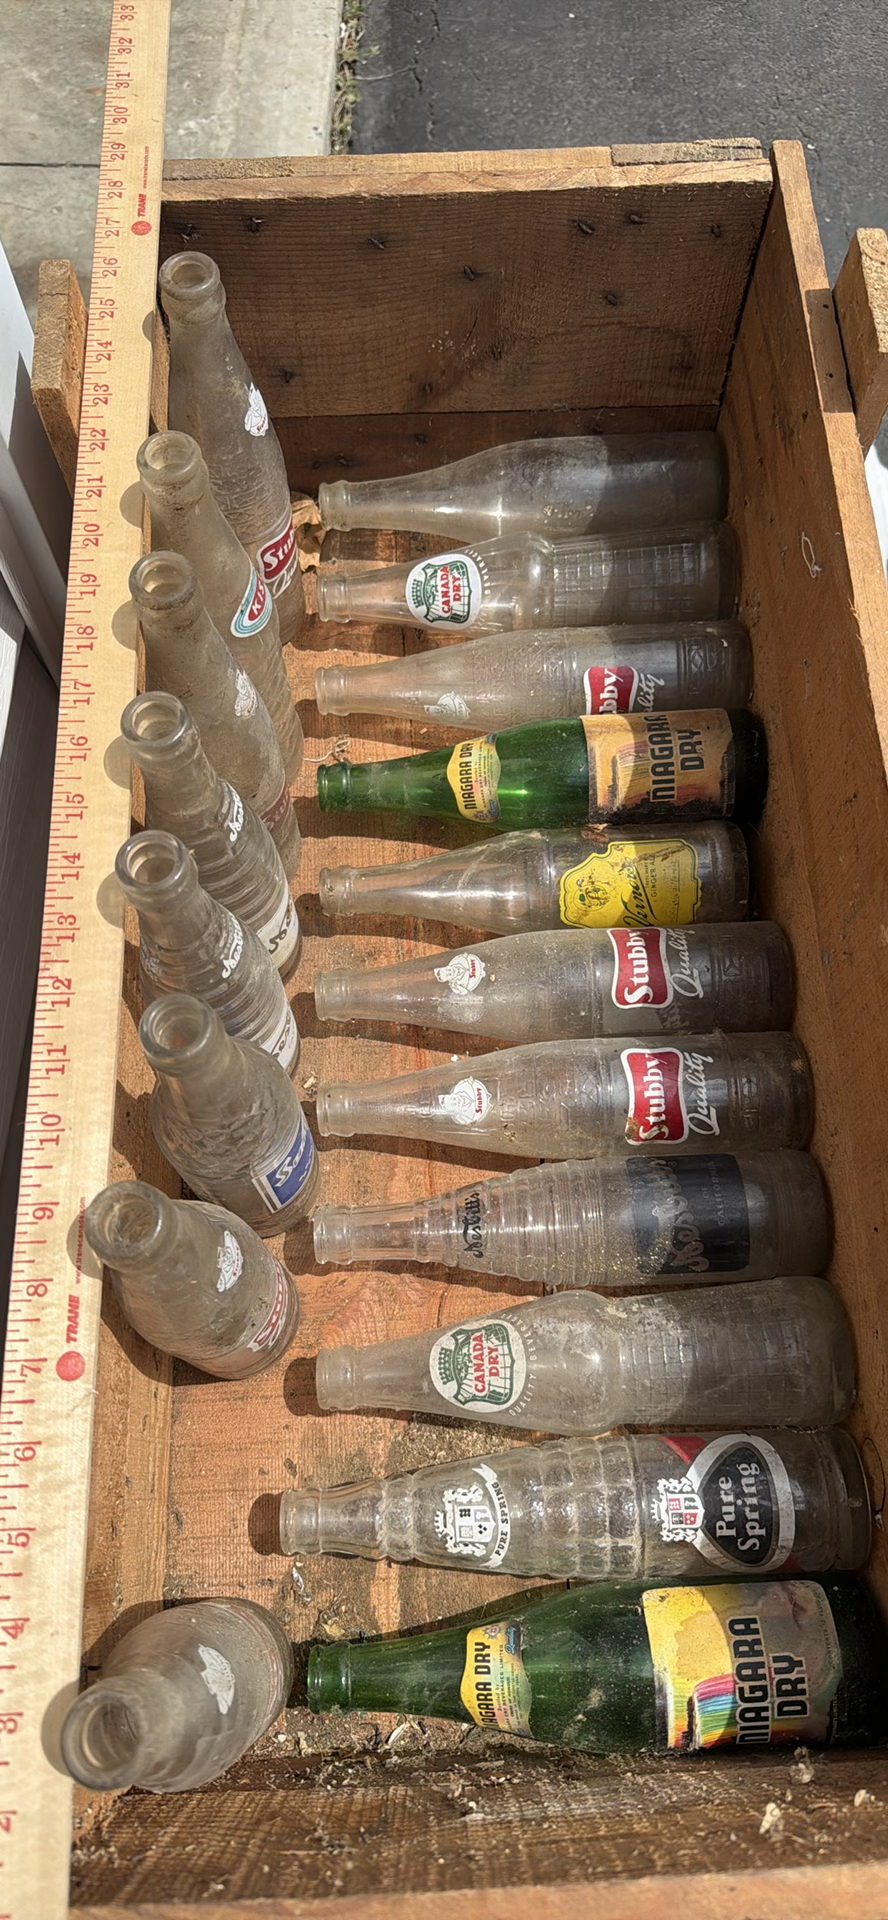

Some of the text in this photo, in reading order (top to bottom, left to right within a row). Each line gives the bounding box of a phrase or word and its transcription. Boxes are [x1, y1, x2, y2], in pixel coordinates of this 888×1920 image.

[120, 4, 135, 21] 33
[117, 37, 132, 54] 32
[115, 71, 130, 89] 31
[113, 106, 128, 124] 30
[110, 142, 126, 161] 29
[107, 180, 123, 199] 28
[137, 193, 147, 218] TRANE
[106, 218, 121, 237] 27
[103, 257, 118, 277] 26
[99, 298, 115, 319] 25
[96, 341, 112, 362] 24
[92, 383, 110, 405] 23
[89, 429, 106, 451] 22
[86, 476, 103, 499] 21
[83, 524, 100, 547] 20
[80, 574, 97, 597] 19
[252, 578, 265, 615] KIS
[440, 566, 451, 614] CANADA
[452, 575, 462, 603] DRY
[76, 625, 94, 652] 18
[73, 681, 91, 706] 17
[599, 667, 623, 714] bby
[69, 736, 88, 762] 16
[643, 714, 675, 801] NIAGARA
[676, 729, 705, 771] DRY
[459, 742, 477, 809] NIAGARA DRY
[66, 793, 84, 820] 15
[61, 852, 80, 881] 14
[56, 914, 76, 943] 13
[624, 931, 653, 1004] Stubby
[667, 928, 703, 999] Quality
[51, 977, 72, 1008] 12
[45, 1044, 66, 1076] 11
[638, 1053, 669, 1139] Stubby
[683, 1052, 720, 1136] Quality
[40, 1114, 62, 1147] 10
[33, 1206, 54, 1220] 9
[461, 1192, 484, 1259] Nesbitt's
[75, 1197, 86, 1284] www.tranecanada.com
[26, 1283, 48, 1298] 8
[66, 1294, 80, 1344] TRANE
[20, 1364, 42, 1378] 7
[472, 1333, 486, 1393] CANADA
[487, 1346, 499, 1377] DRY
[508, 1373, 536, 1417] QUALITY
[14, 1446, 36, 1462] 6
[491, 1481, 509, 1556] PURE SPRING
[715, 1476, 737, 1538] Pure
[736, 1463, 766, 1550] Spring
[8, 1532, 30, 1548] 5
[3, 1622, 25, 1639] 4
[474, 1642, 499, 1727] IAGARA DRY
[499, 1672, 507, 1706] BEVERAGES
[728, 1617, 771, 1743] NIAGARA
[772, 1653, 809, 1718] DRY
[0, 1718, 18, 1734] 3
